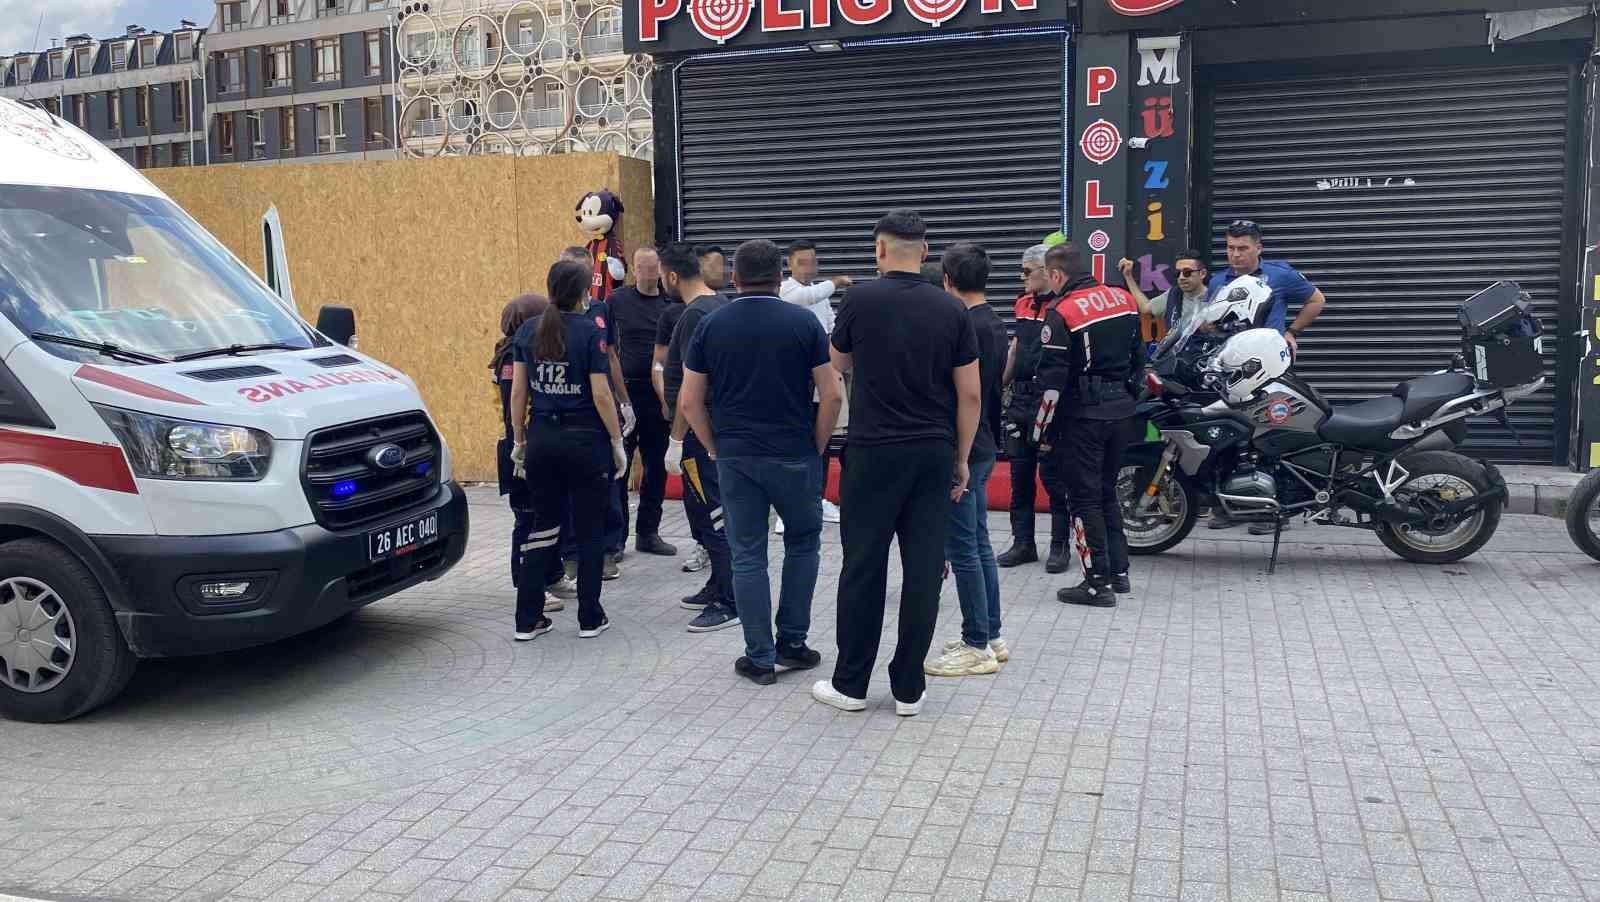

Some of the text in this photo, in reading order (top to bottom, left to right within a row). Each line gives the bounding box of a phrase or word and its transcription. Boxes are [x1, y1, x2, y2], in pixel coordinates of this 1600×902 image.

[536, 364, 566, 383] 112
[377, 532, 391, 554] 26
[396, 523, 415, 548] AEC
[419, 516, 435, 539] 040
